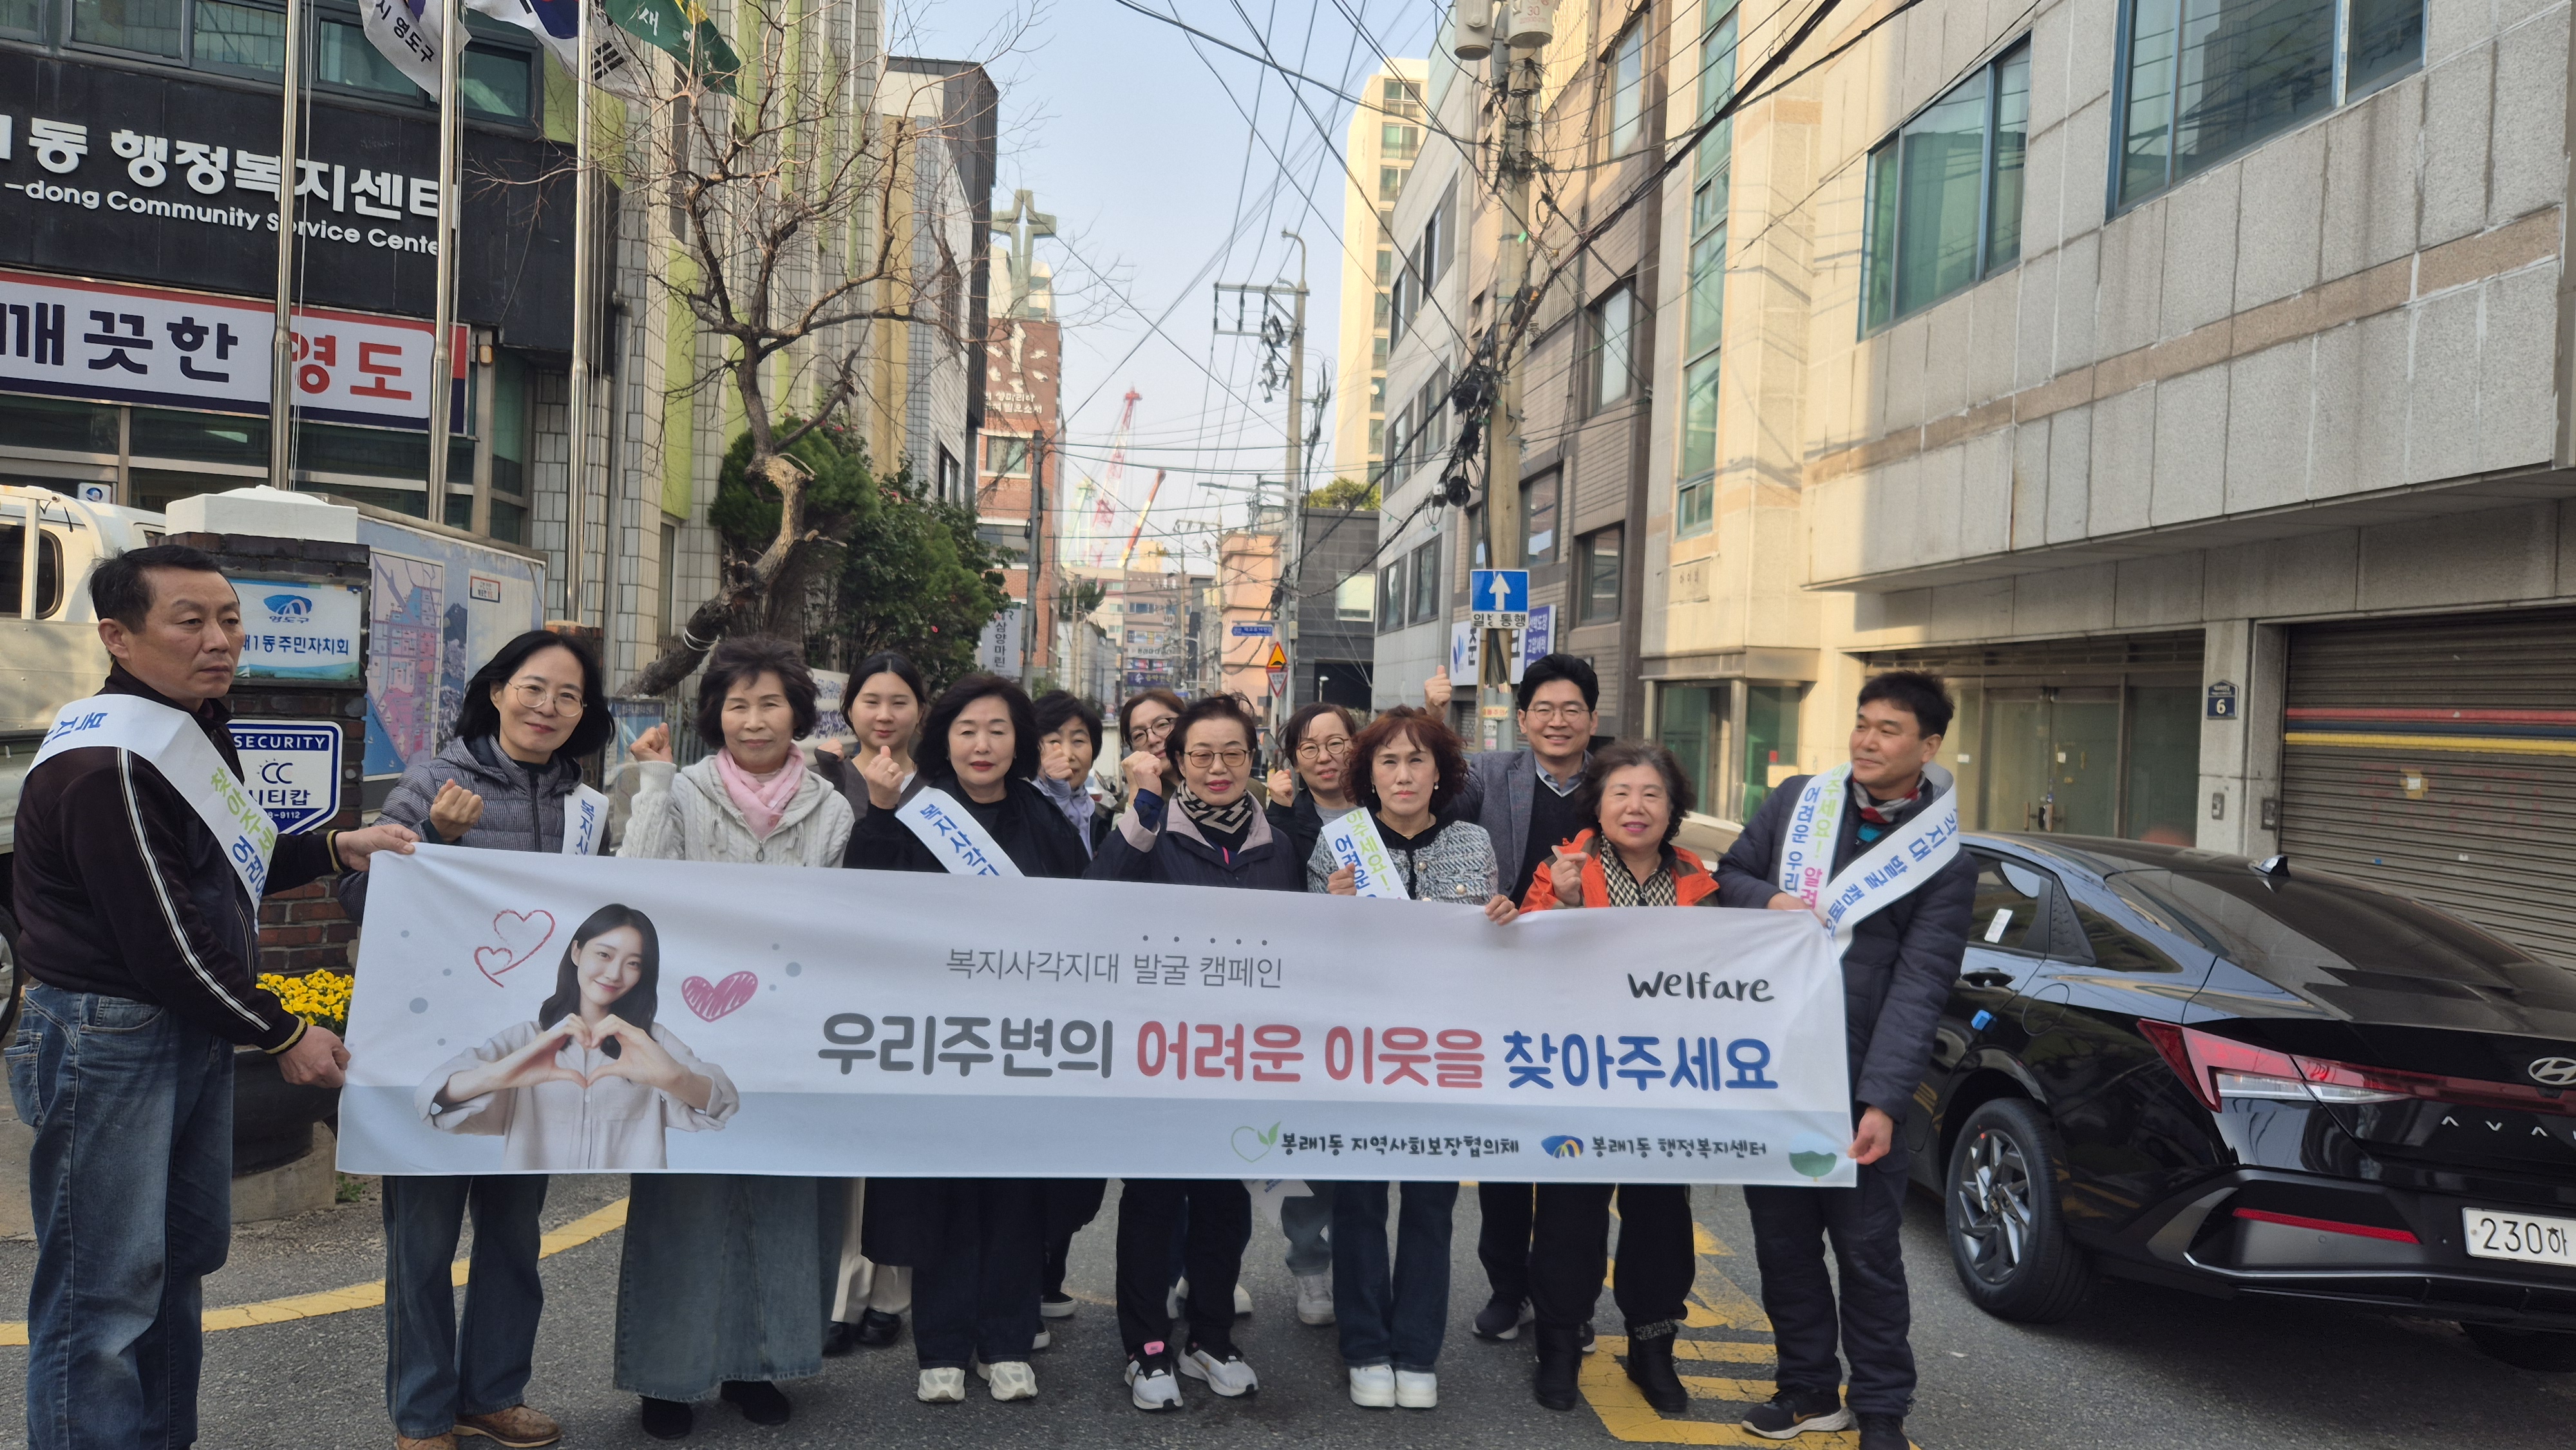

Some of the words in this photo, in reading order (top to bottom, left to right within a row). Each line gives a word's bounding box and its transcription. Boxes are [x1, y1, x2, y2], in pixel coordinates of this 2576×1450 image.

[1528, 6, 1540, 16] 30
[393, 17, 435, 62] 영도구
[111, 129, 459, 230] 행정복지센터
[107, 191, 260, 231] Community
[266, 212, 361, 243] Srvice
[368, 228, 438, 256] Cente
[0, 303, 238, 383] 깨끗한
[291, 330, 412, 401] 영도
[269, 616, 310, 624] 영도구
[994, 621, 1007, 668] 삼양마린
[2217, 699, 2226, 715] 6
[233, 735, 326, 749] SECURITY
[210, 766, 275, 864] 찾아주세
[574, 798, 595, 855] 복지사
[1791, 786, 1821, 844] 어려운
[1908, 807, 1958, 863] 각지대
[1784, 851, 1803, 893] 우리
[1863, 854, 1908, 890] 발굴
[946, 948, 1119, 984] 복지사각지대
[1133, 954, 1190, 986] 발굴
[1199, 956, 1282, 988] 캠페인
[818, 1013, 1113, 1078] 우리주변의
[1137, 1021, 1305, 1082] 어려운
[1325, 1025, 1485, 1089] 이웃을
[1502, 1030, 1779, 1091] 찾아주세요
[1281, 1133, 1345, 1156] 봉래1동
[1351, 1135, 1520, 1158] 지역사회보장협의체
[1591, 1136, 1652, 1158] 봉래1동
[1657, 1136, 1767, 1158] 행정복지센터
[2441, 1115, 2576, 1140] AVA
[2479, 1218, 2568, 1257] 230하
